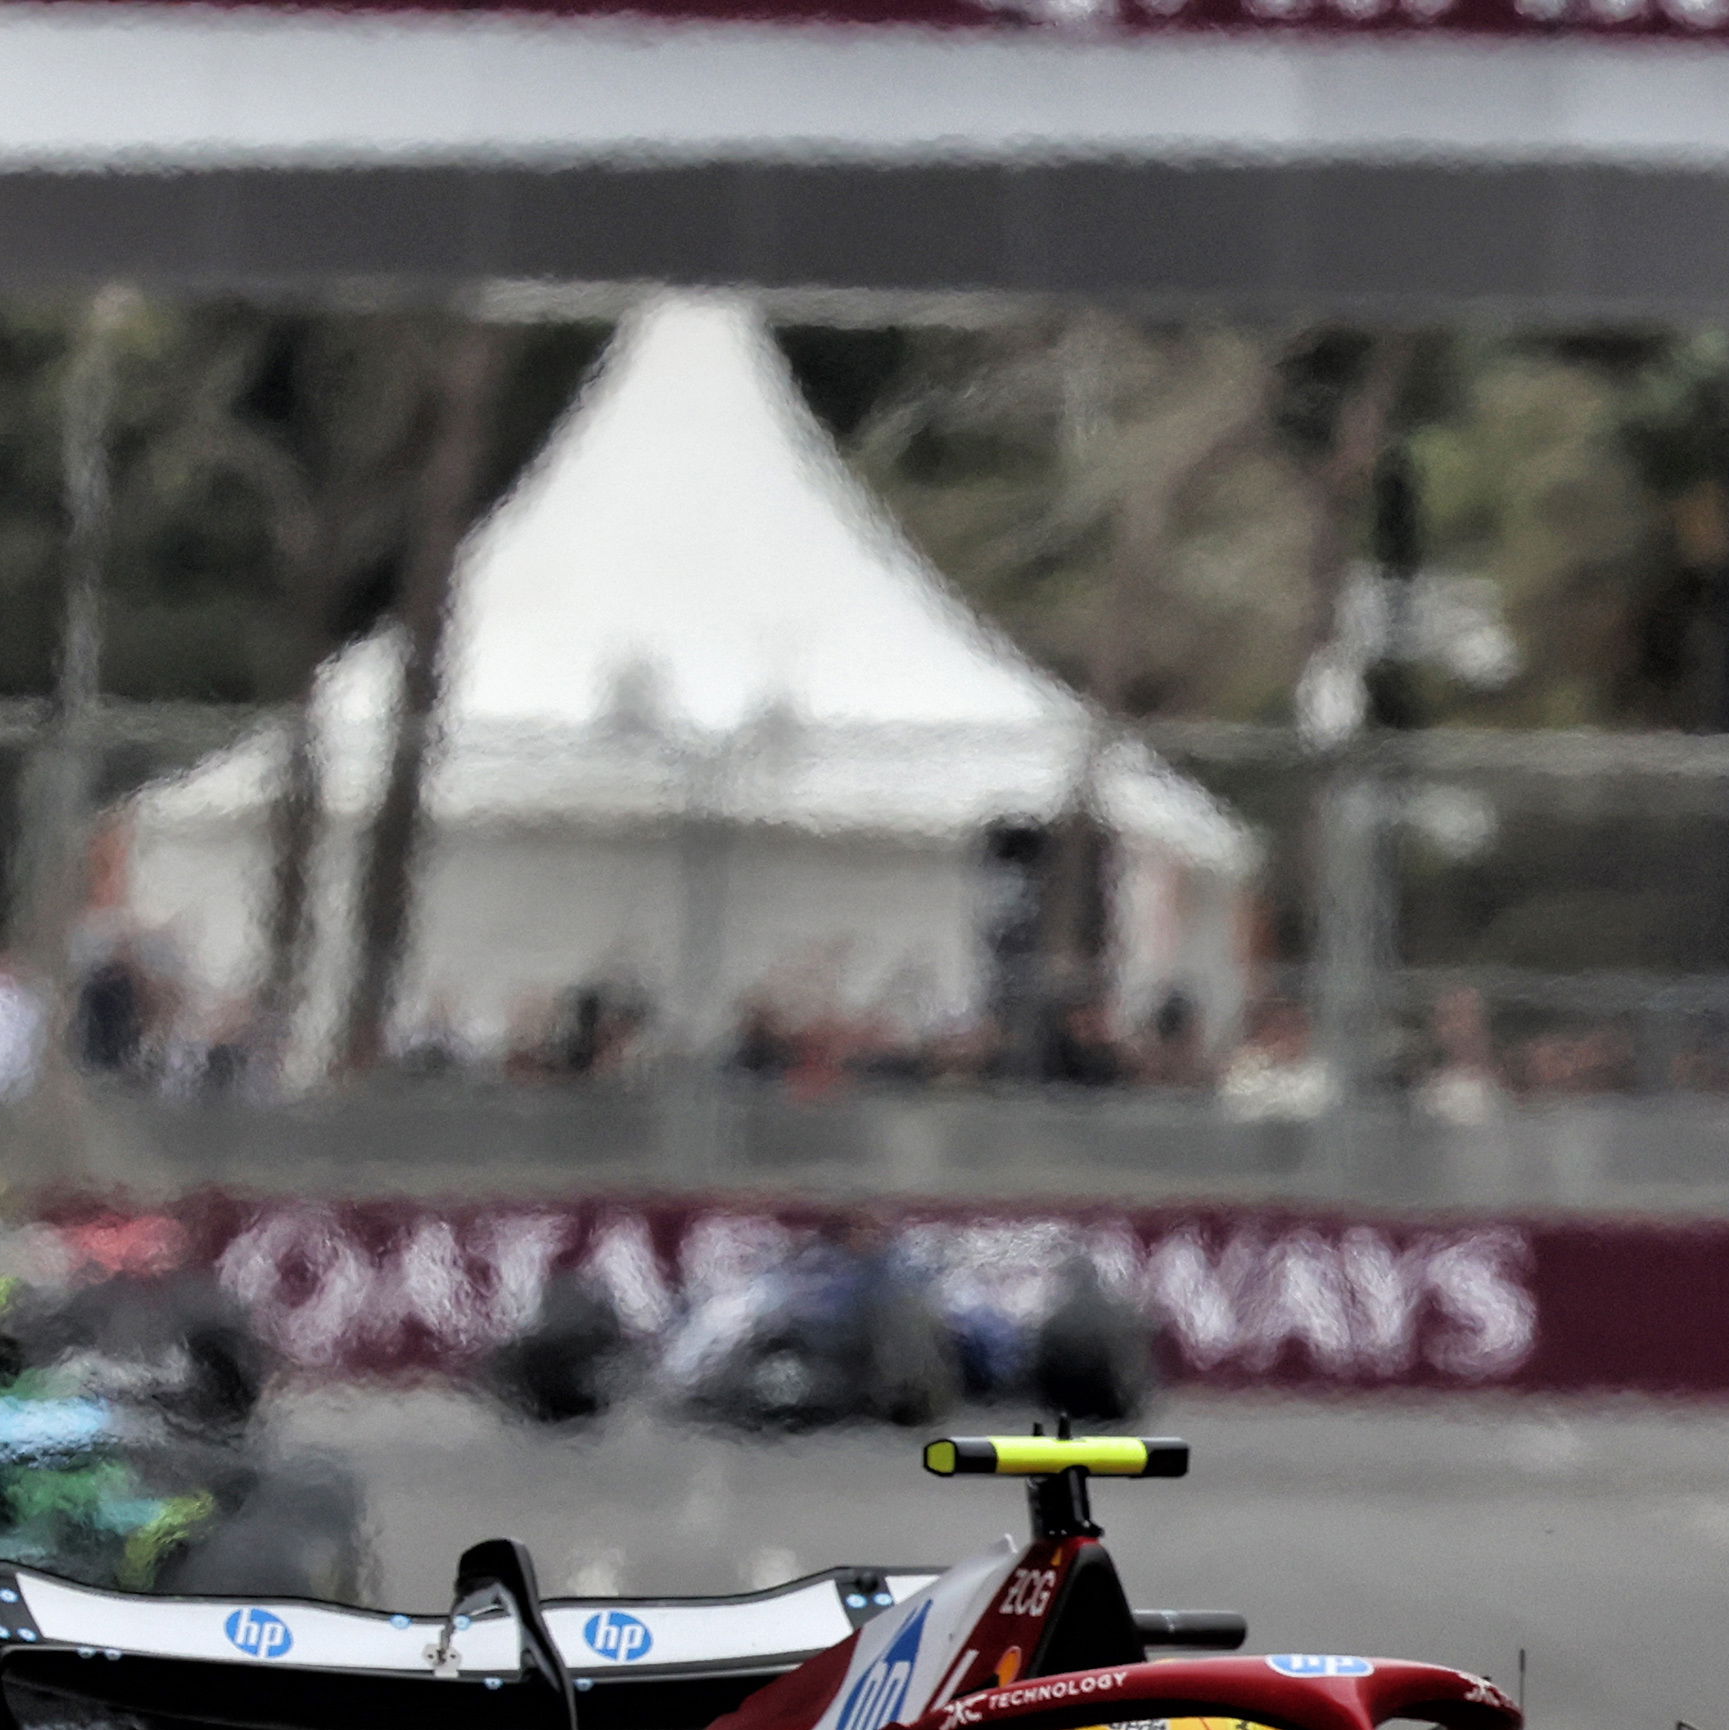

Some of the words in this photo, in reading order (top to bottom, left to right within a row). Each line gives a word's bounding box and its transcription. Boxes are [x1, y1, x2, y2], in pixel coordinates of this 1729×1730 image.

[234, 1606, 284, 1659] hp
[594, 1610, 646, 1662] hp
[987, 1671, 1128, 1711] TECHNOLOGY
